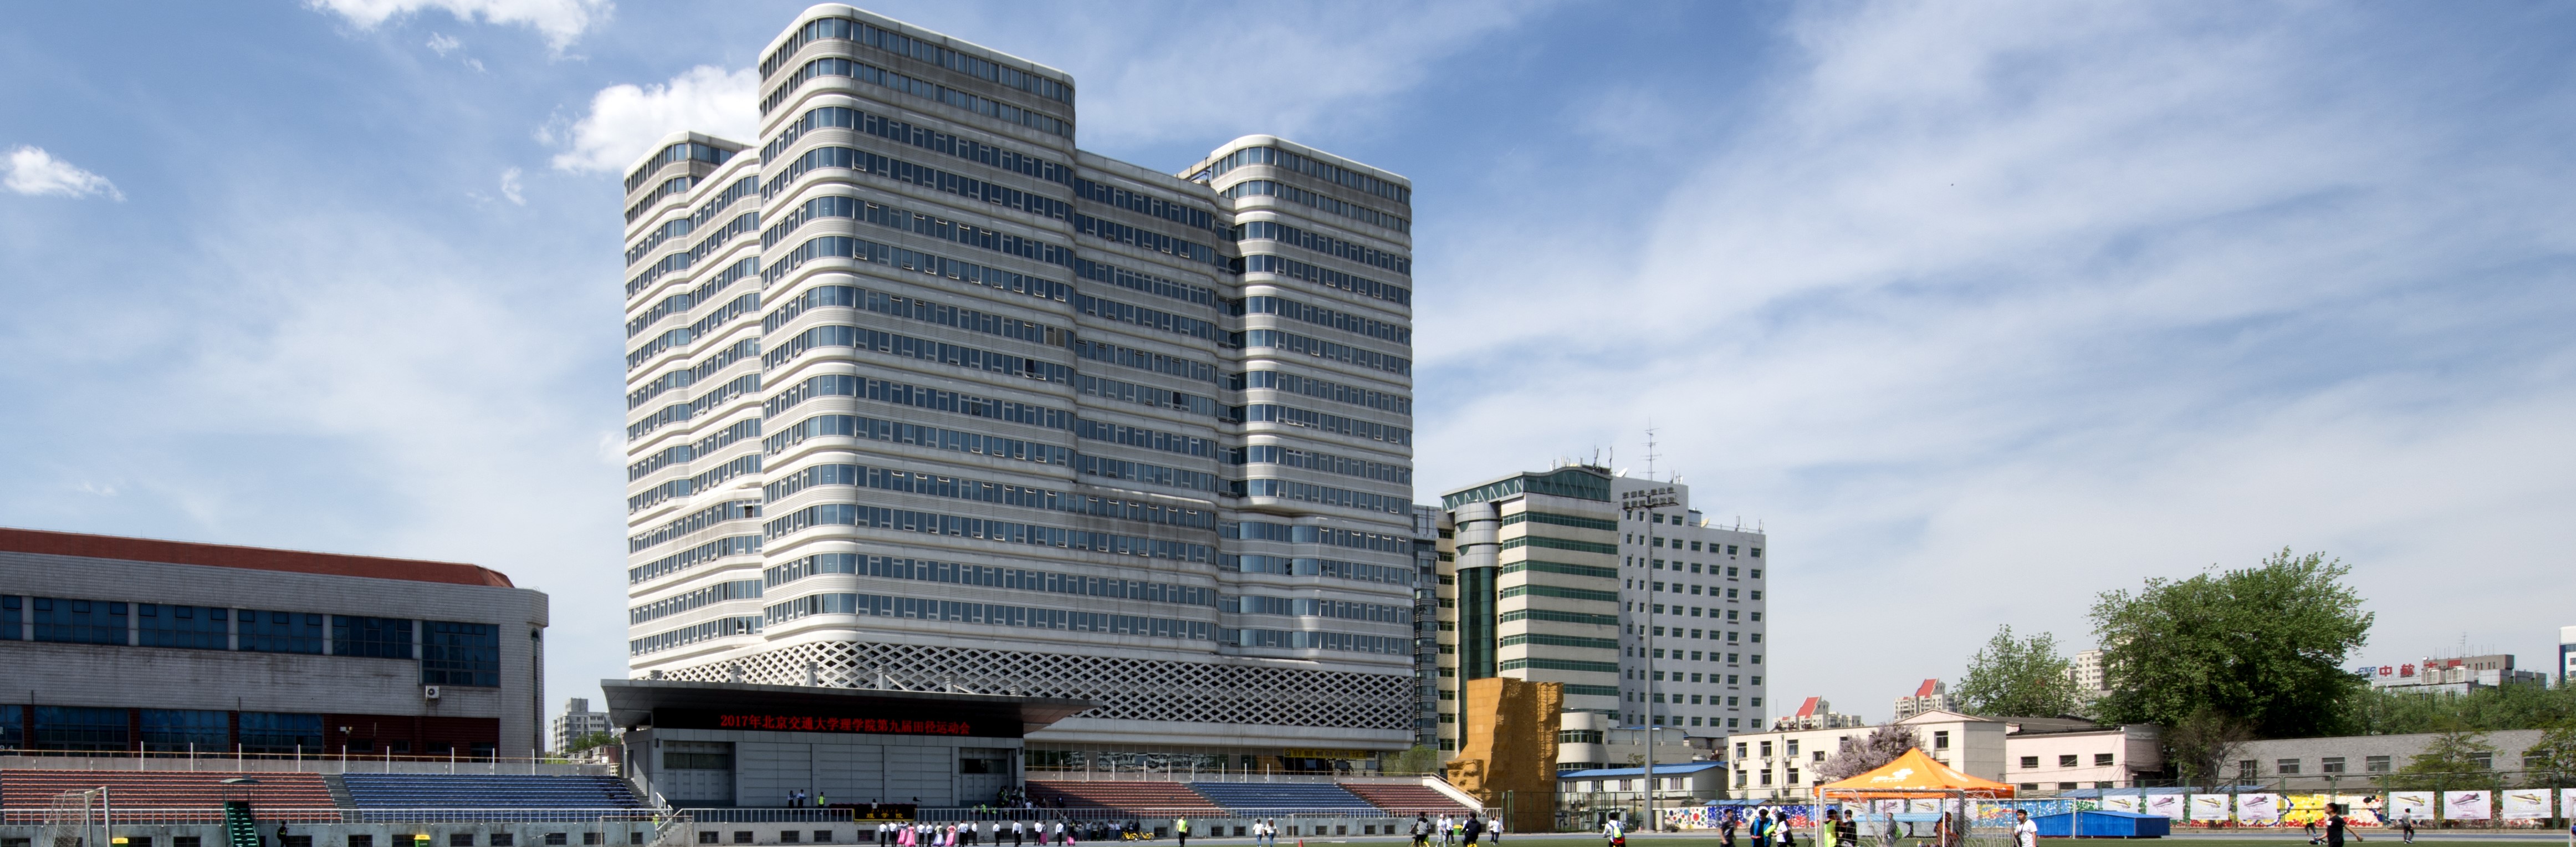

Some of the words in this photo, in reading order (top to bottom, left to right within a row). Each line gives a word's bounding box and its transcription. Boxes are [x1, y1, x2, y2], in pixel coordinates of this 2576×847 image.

[720, 715, 970, 734] 2017年北京交通大学理学院第九届田径运动会
